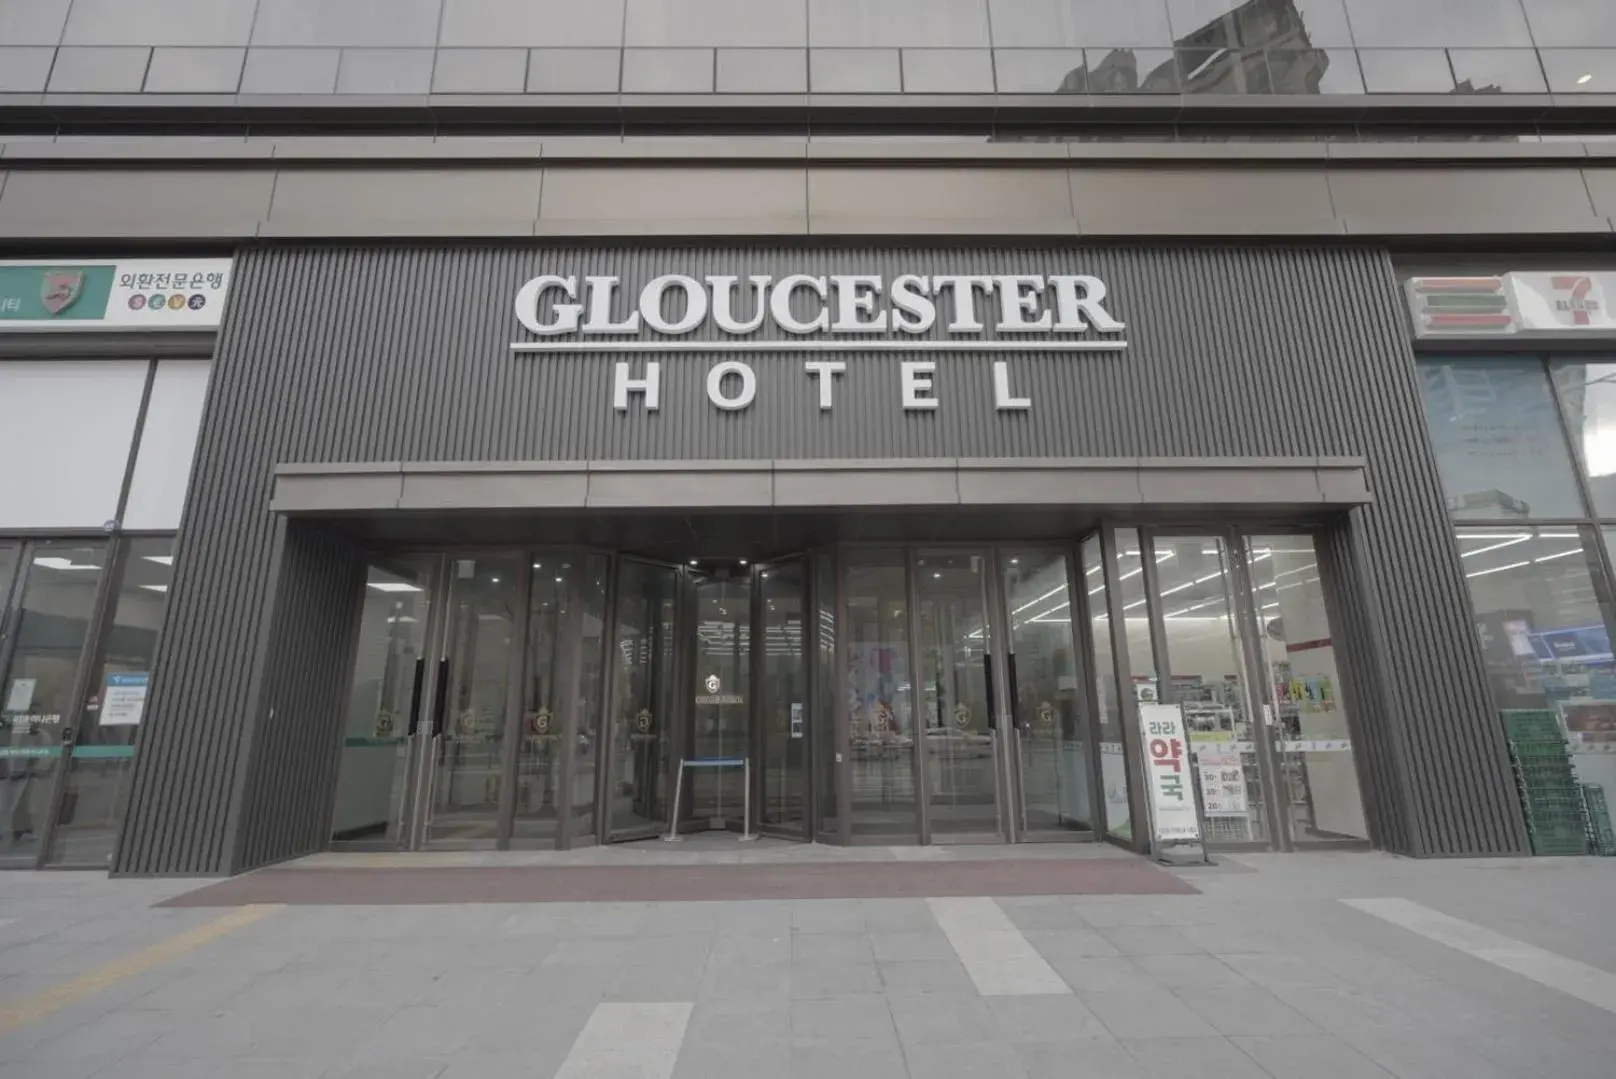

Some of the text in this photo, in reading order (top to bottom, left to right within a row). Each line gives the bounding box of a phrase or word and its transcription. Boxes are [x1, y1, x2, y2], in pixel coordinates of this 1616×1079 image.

[119, 271, 224, 290] 외환전문은행
[514, 274, 1126, 336] GLOUCESTER
[613, 361, 1032, 411] HOTEL
[1149, 721, 1177, 736] 라라
[1149, 738, 1184, 803] 약국
